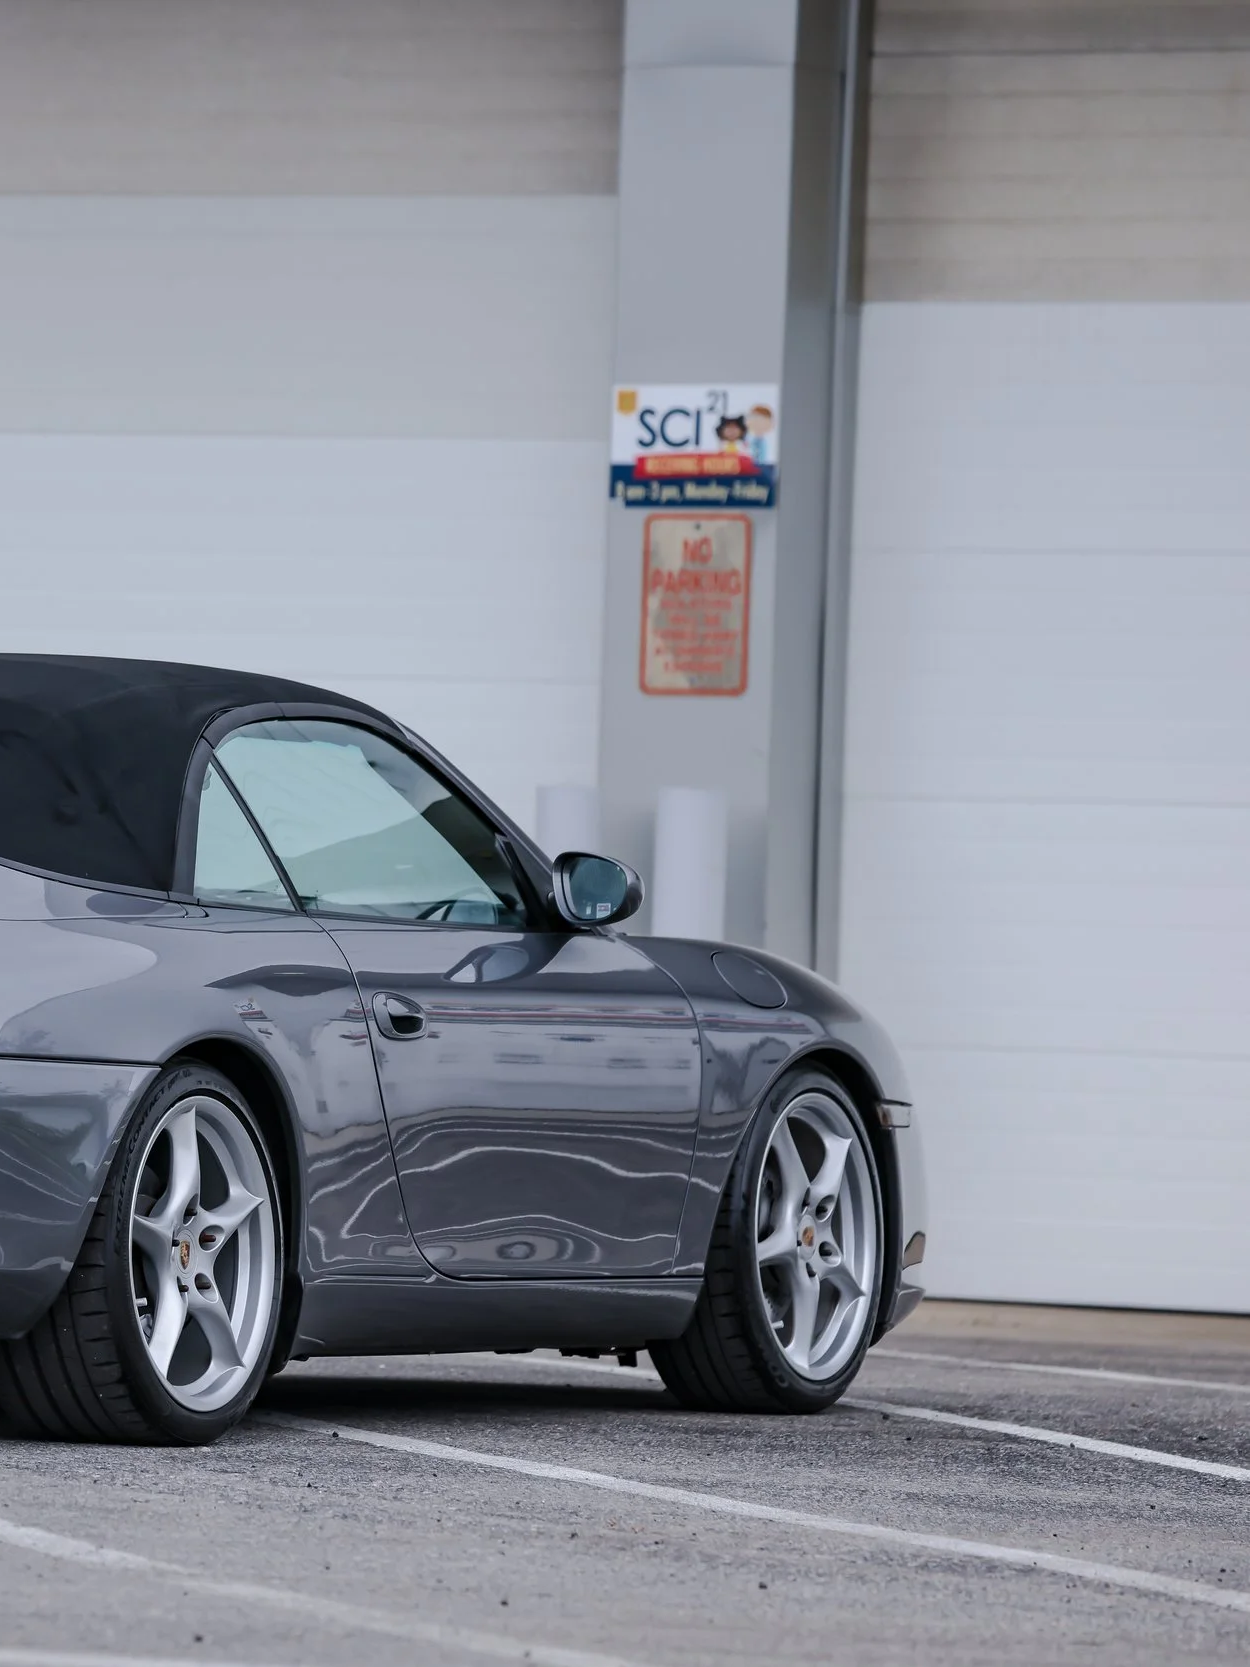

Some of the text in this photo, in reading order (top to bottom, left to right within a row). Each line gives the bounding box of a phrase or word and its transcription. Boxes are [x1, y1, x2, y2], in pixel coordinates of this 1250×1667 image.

[638, 408, 700, 447] SCI
[682, 537, 714, 564] NO
[651, 568, 742, 595] PARKING
